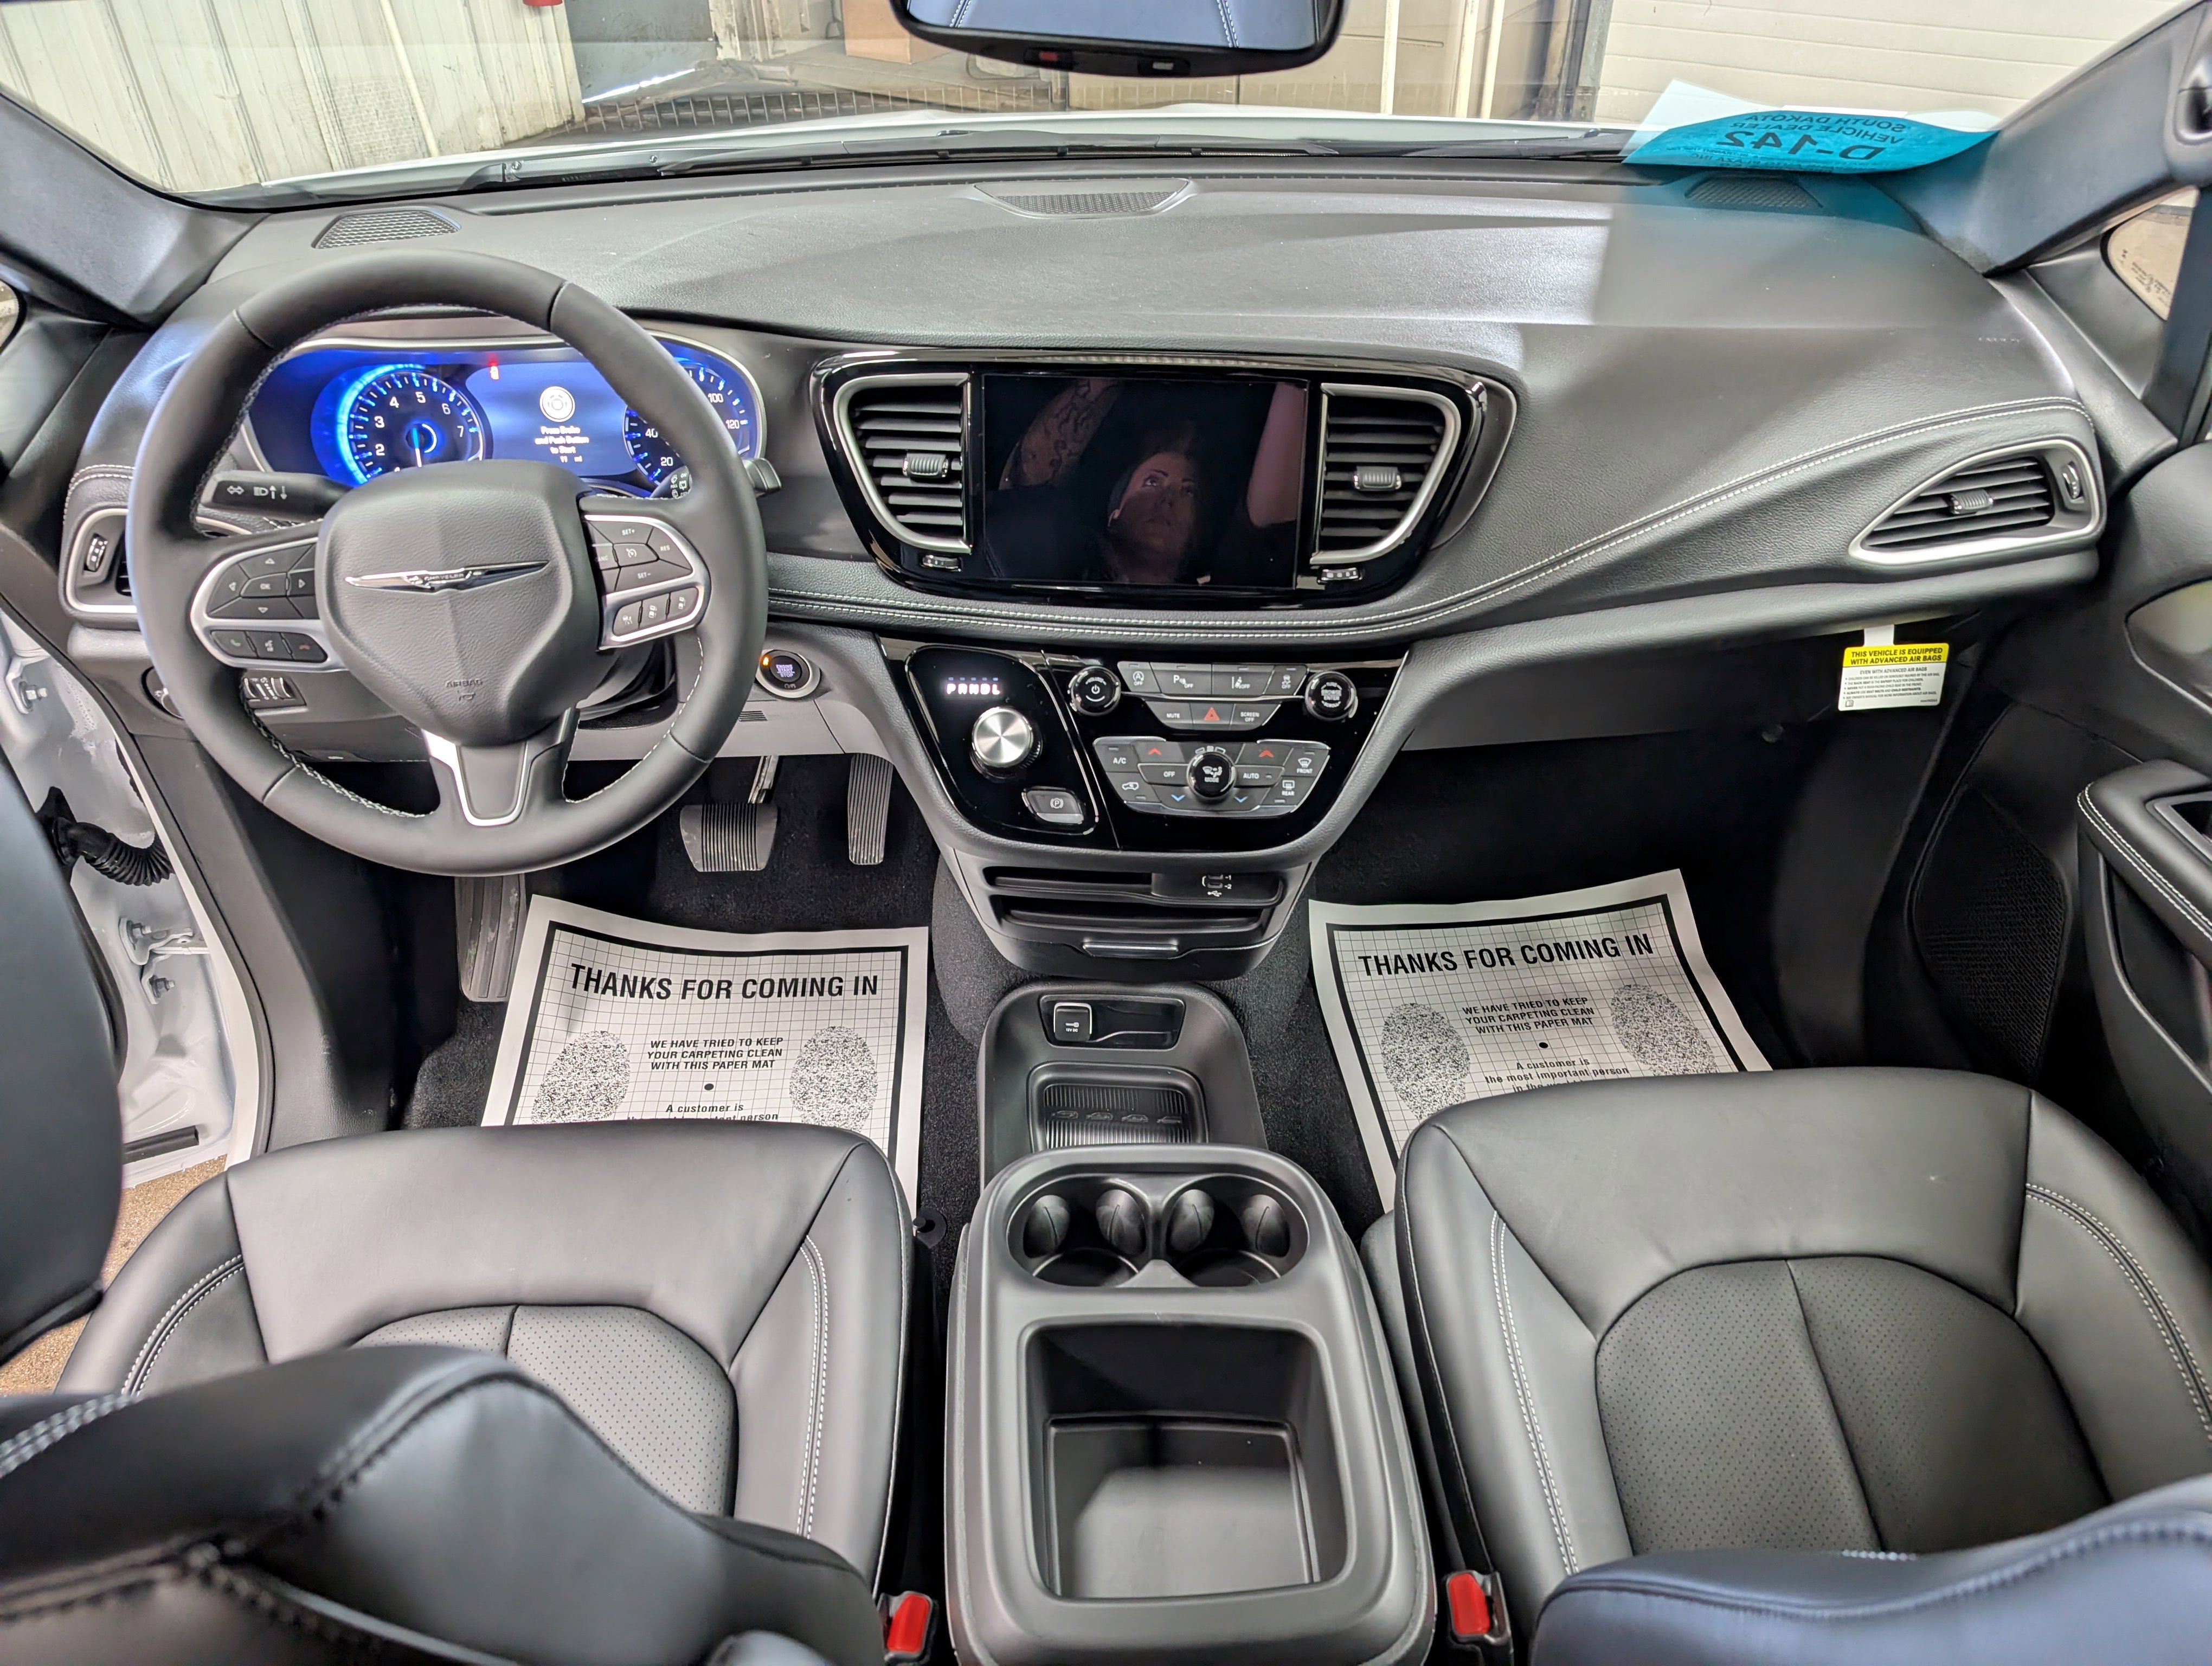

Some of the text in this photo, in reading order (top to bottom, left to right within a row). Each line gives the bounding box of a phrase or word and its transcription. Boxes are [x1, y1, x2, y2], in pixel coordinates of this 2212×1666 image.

[389, 396, 399, 408] 4
[415, 391, 426, 403] 5
[708, 393, 724, 403] 100
[442, 403, 451, 415] 6
[374, 415, 385, 428] 3
[726, 419, 740, 429] 120
[457, 426, 464, 437] 7
[645, 428, 658, 438] 40
[375, 444, 385, 456] 2
[661, 457, 673, 466] 20
[1113, 757, 1127, 765] A/C
[1358, 933, 1654, 976] THANKS FOR COMING IN
[571, 963, 878, 1000] THANKS FOR COMING IN
[1462, 997, 1588, 1015] WE HAVE TRIED TO KEEP
[1465, 1007, 1595, 1024] YOUR CARPETING CLEAN
[1475, 1017, 1593, 1034] WITH THIS PAPER MAT
[651, 1037, 783, 1048] WE HAVE TRIED TO KEEP
[647, 1048, 782, 1059] YOUR CARPETING CLEAN
[651, 1060, 775, 1070] WITH THIS PAPER MAT
[1527, 1059, 1576, 1069] customer
[1580, 1058, 1590, 1066] is
[1485, 1067, 1630, 1084] the most important person
[1513, 1085, 1523, 1093] in
[666, 1103, 744, 1113] A customer is
